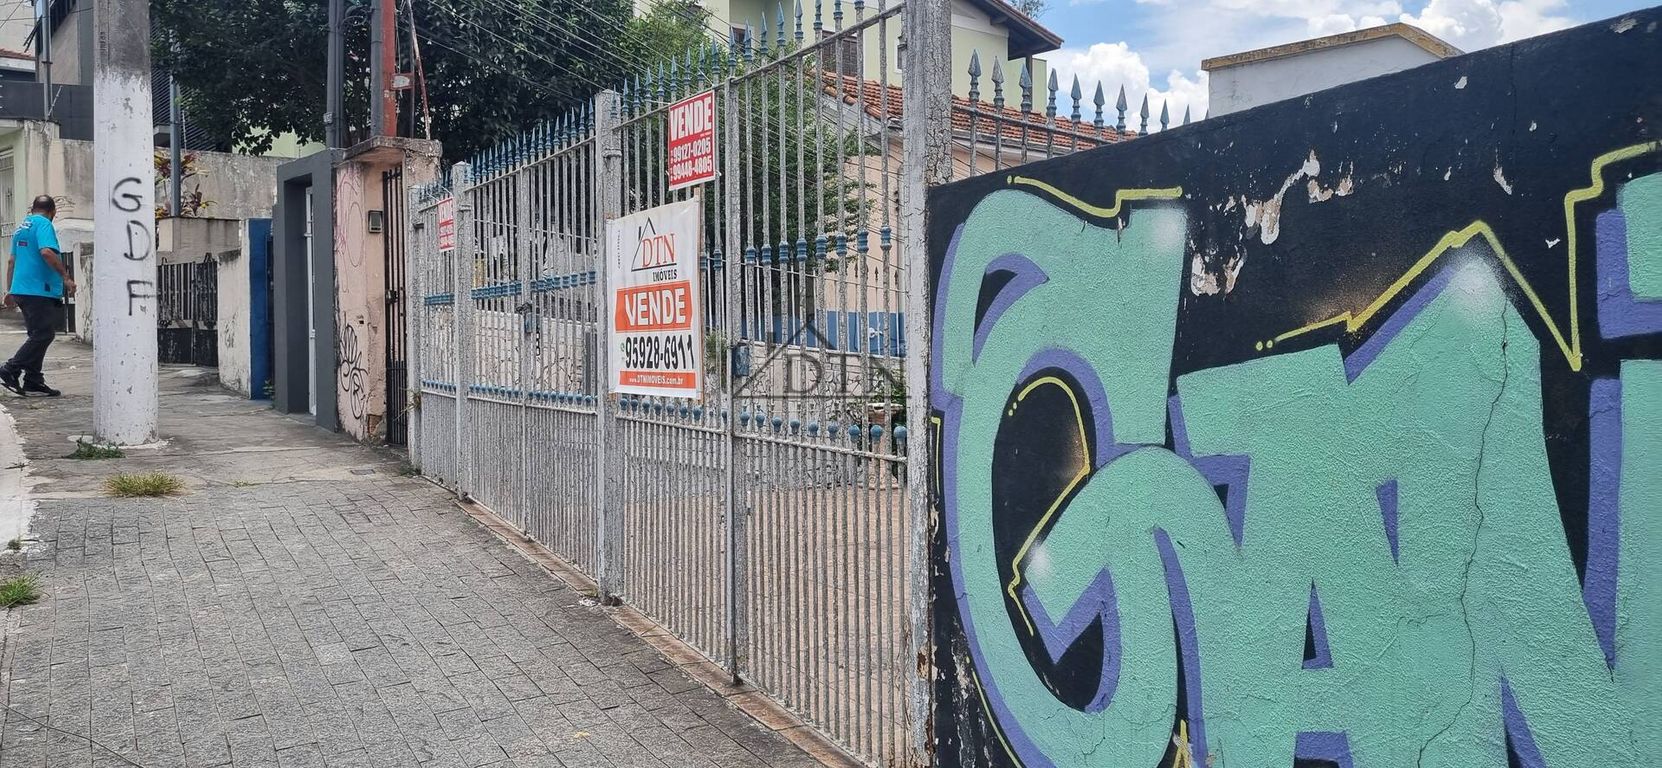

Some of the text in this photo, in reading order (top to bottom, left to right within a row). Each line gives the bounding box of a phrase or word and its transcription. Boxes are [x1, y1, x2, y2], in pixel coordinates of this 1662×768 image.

[670, 96, 712, 141] VENDE
[642, 233, 675, 268] DTN
[652, 268, 678, 282] IMÓVEIS
[624, 287, 686, 326] VENDE
[625, 334, 695, 370] 95928-6911
